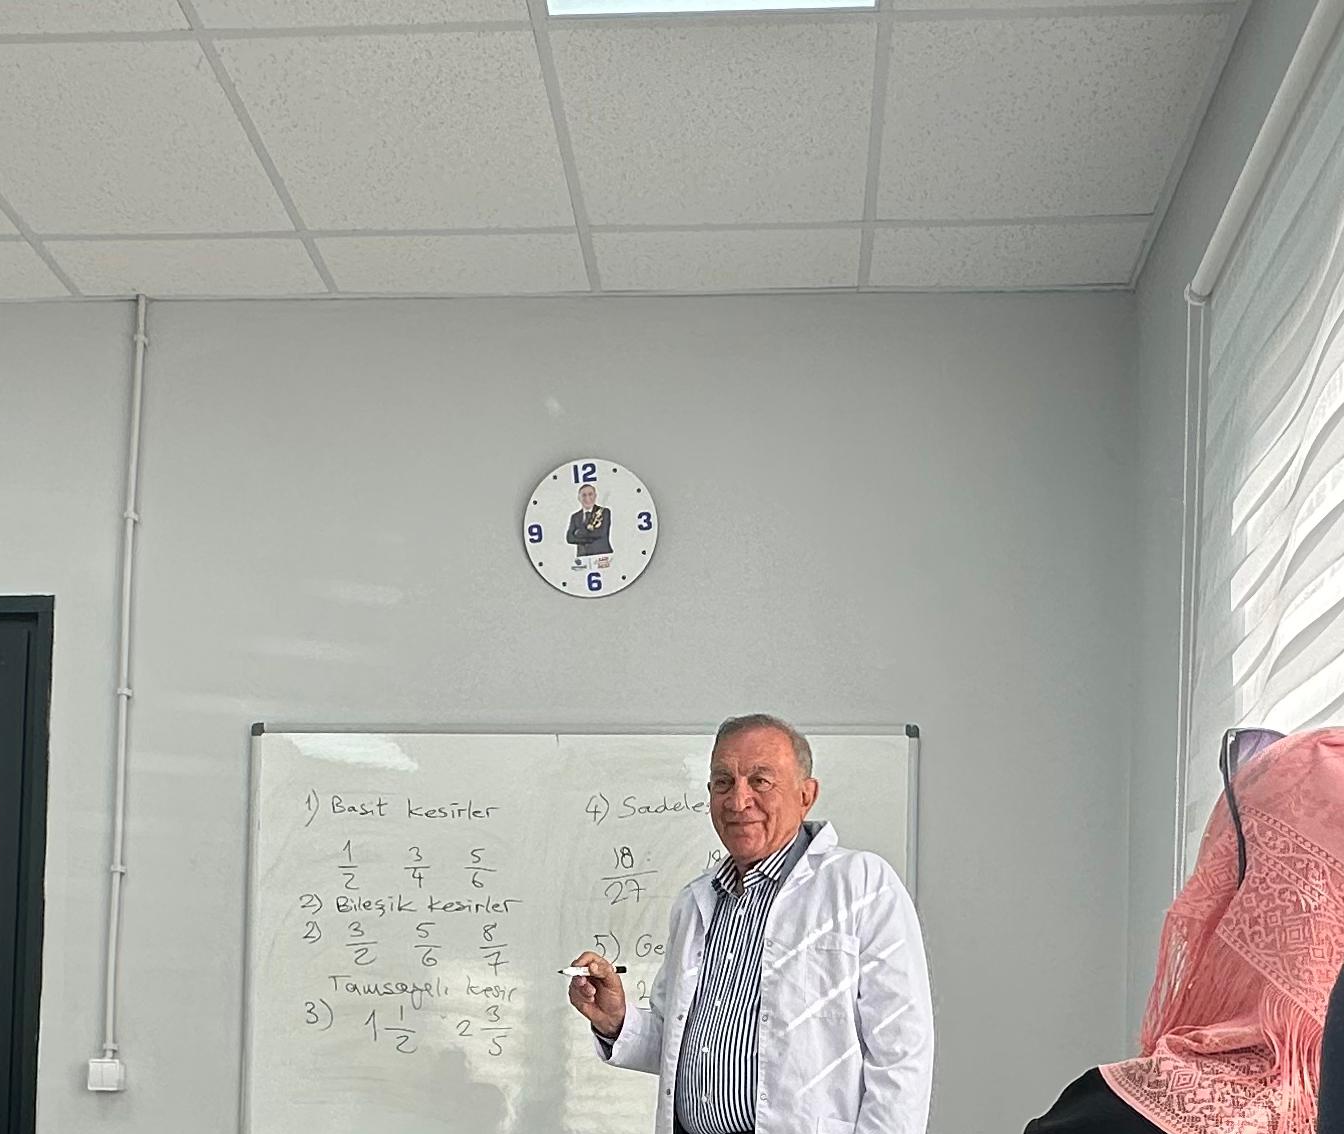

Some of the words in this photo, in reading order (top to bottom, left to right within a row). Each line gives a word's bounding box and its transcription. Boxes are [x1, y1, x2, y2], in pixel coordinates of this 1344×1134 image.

[573, 463, 597, 483] 12
[528, 524, 543, 543] 9
[637, 512, 653, 531] 3
[587, 572, 602, 591] 6
[305, 788, 320, 827] 1)
[332, 795, 388, 816] Basit
[585, 792, 609, 826] 4)
[343, 840, 352, 862] 1
[409, 847, 423, 862] 3
[470, 848, 485, 864] 5
[613, 846, 634, 869] 18
[342, 873, 360, 890] 2
[411, 868, 424, 888] 4
[472, 872, 484, 888] 6
[605, 879, 646, 905] 27
[299, 893, 323, 915] 2)
[336, 894, 417, 917] Bileşik
[303, 920, 322, 944] 2)
[348, 921, 365, 937] 3
[416, 922, 436, 939] 5
[482, 922, 497, 941] 8
[636, 934, 665, 957] Ge
[354, 948, 378, 966] 2
[421, 948, 438, 967] 6
[483, 951, 509, 976] 7
[305, 998, 334, 1031] 3)
